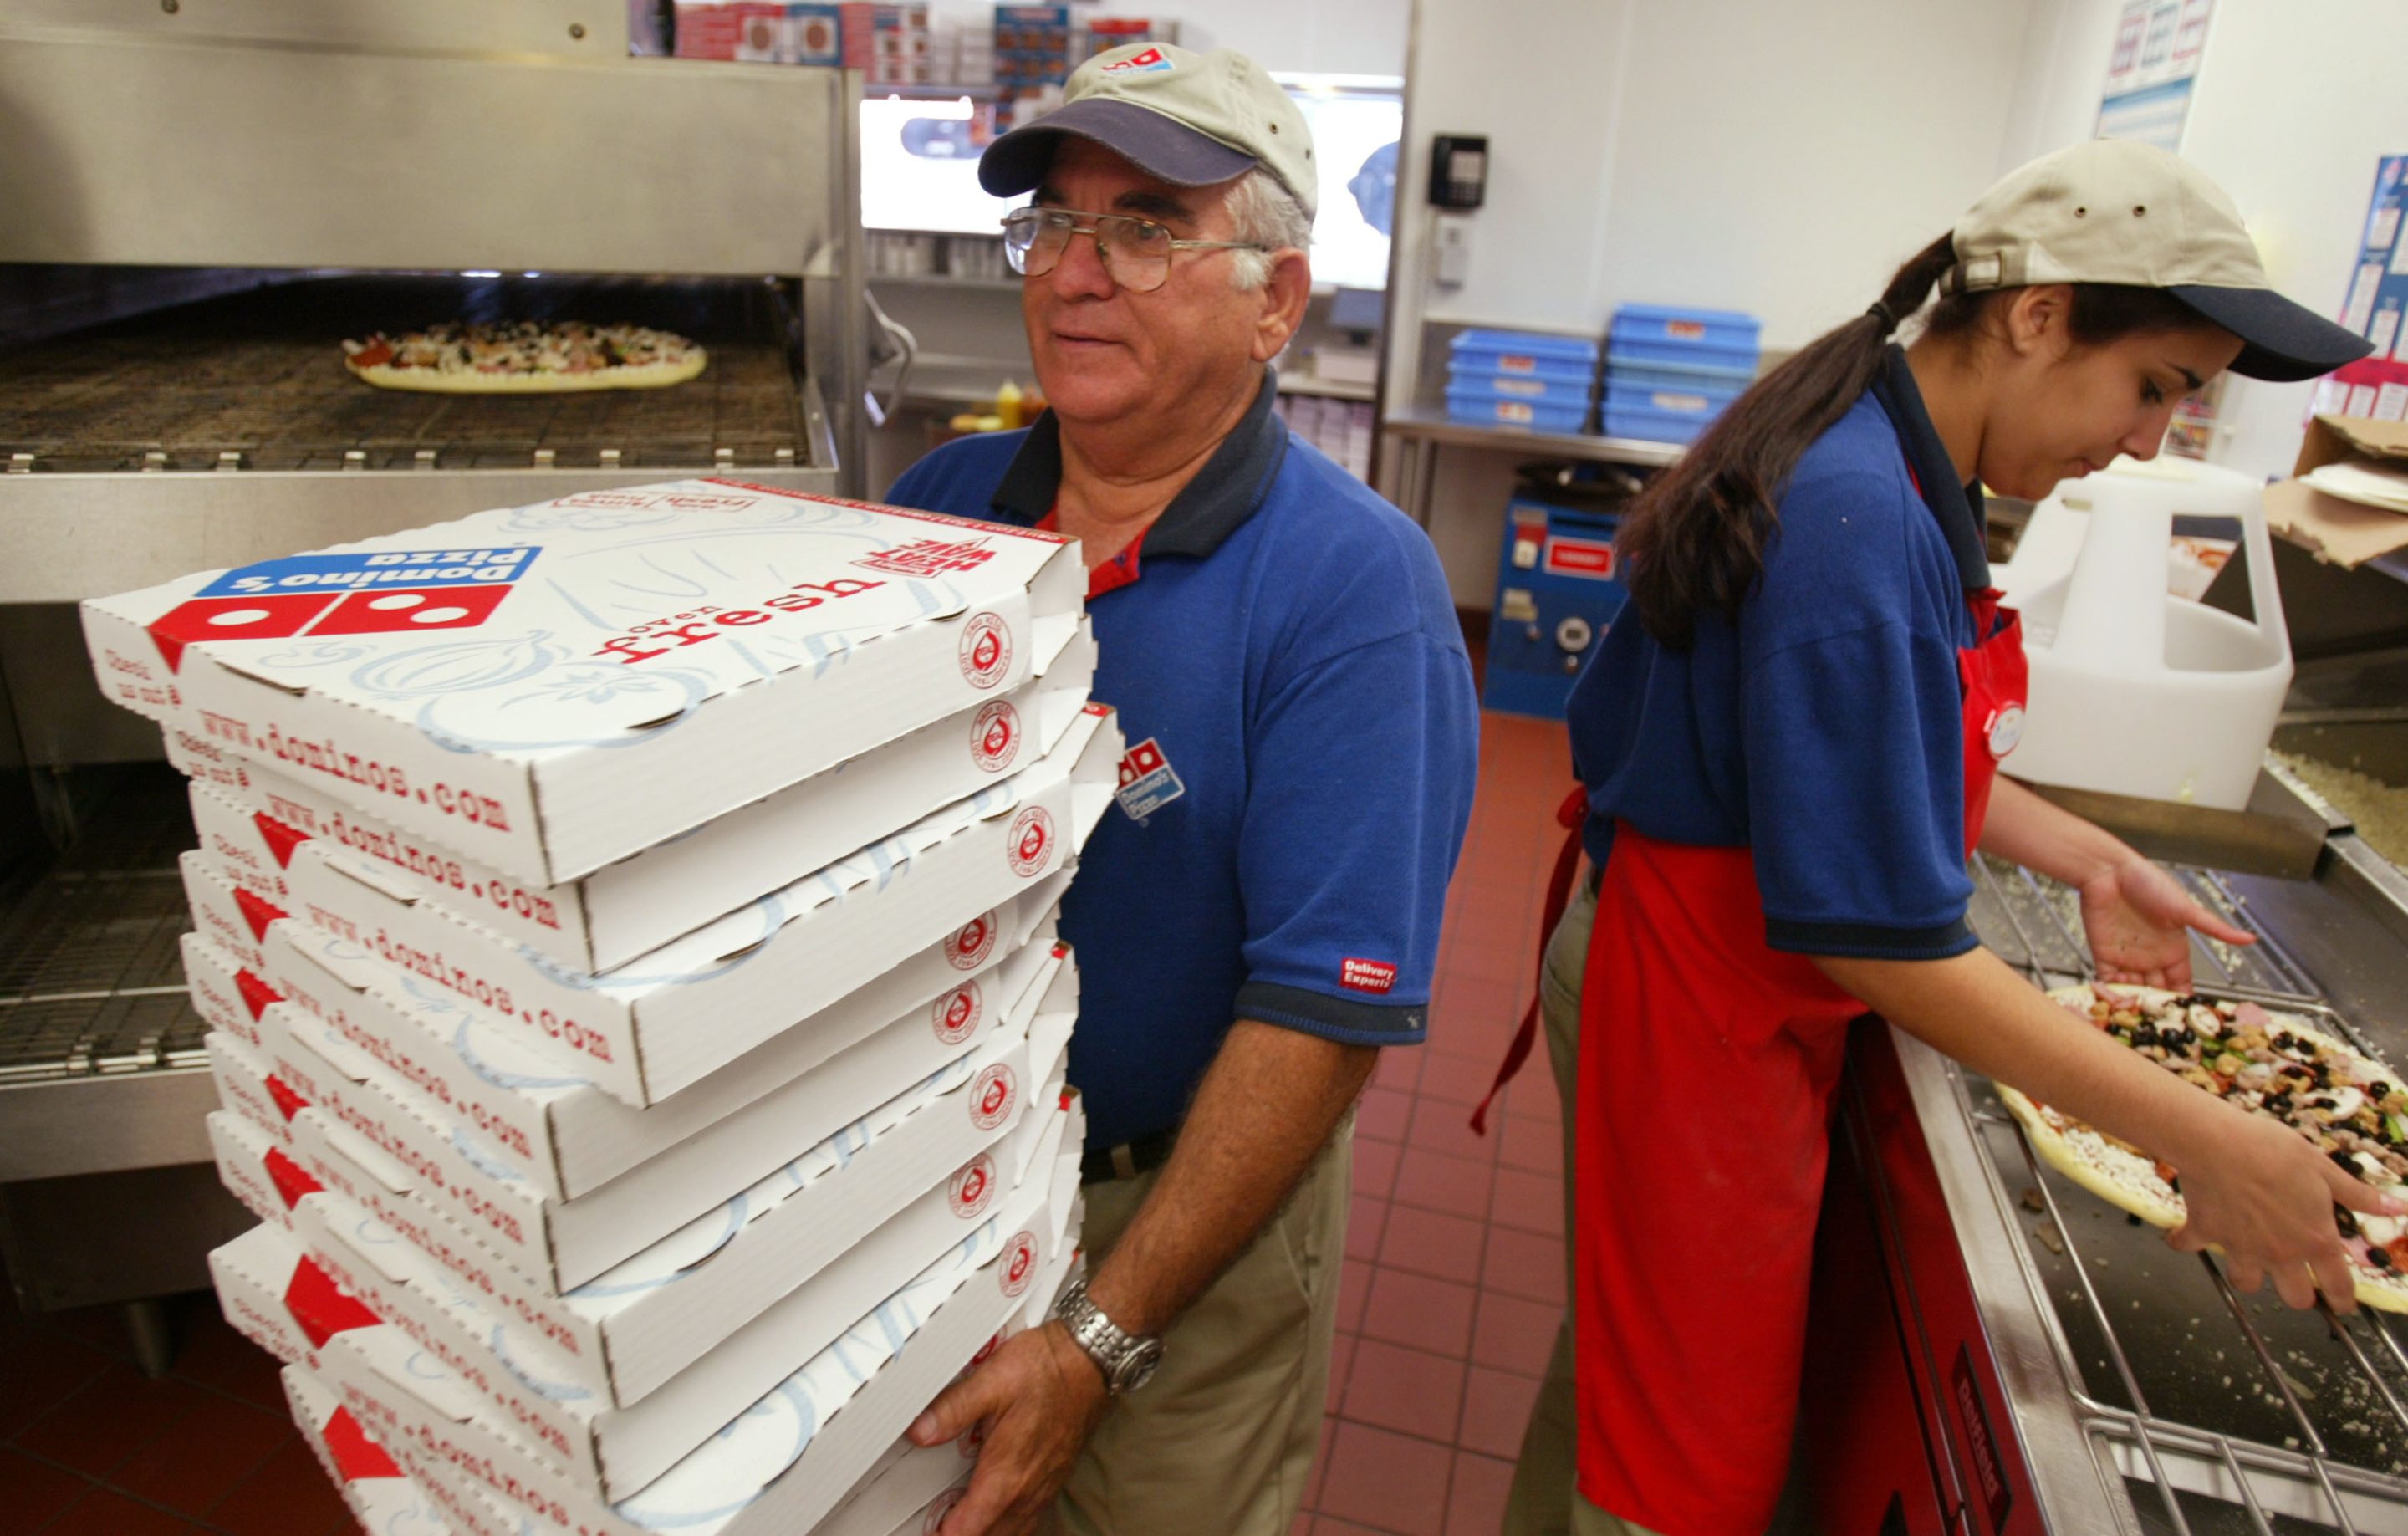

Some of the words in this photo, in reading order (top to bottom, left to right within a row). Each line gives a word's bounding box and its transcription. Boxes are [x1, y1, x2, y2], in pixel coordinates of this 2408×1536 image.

[228, 564, 518, 593] Domino's
[364, 549, 529, 567] Pizza
[589, 579, 888, 665] fresh
[627, 605, 725, 634] oven
[197, 709, 513, 833] www.dominos.com
[266, 792, 562, 931] www.dominos.com
[305, 902, 615, 1064] www.dominos.com
[1344, 959, 1395, 980] Delivery
